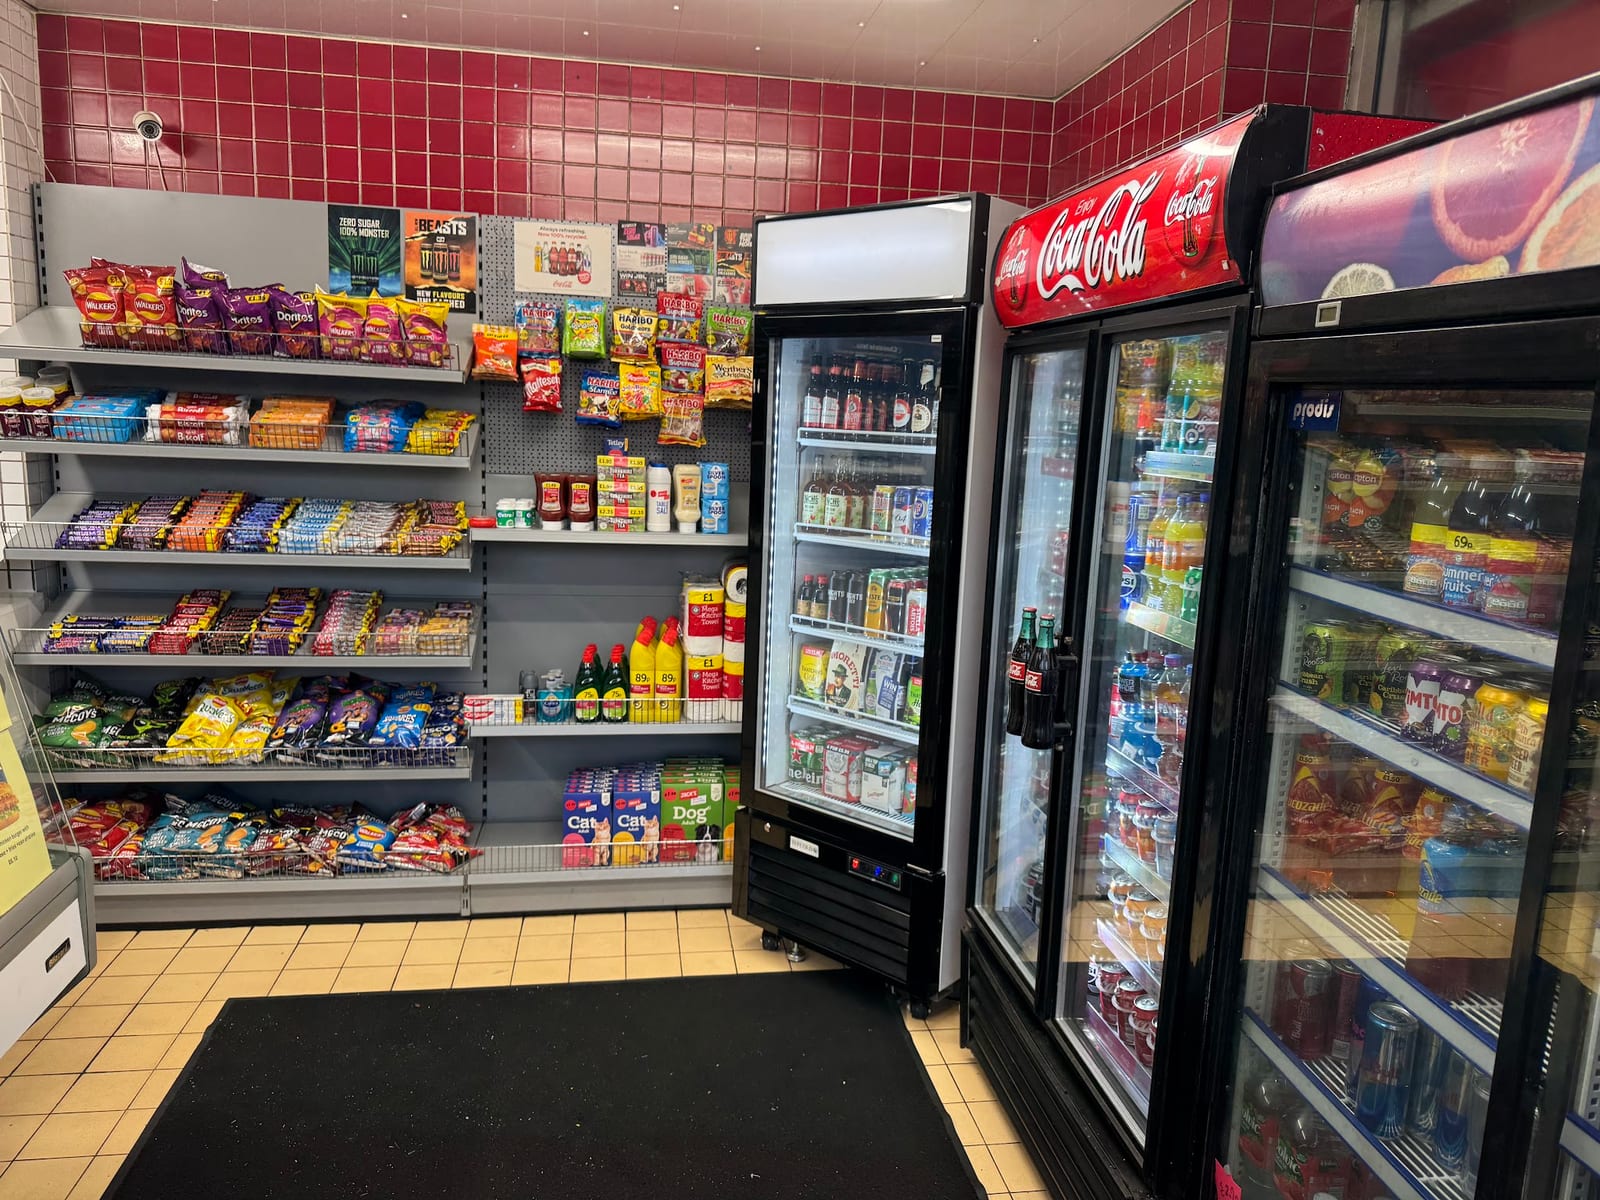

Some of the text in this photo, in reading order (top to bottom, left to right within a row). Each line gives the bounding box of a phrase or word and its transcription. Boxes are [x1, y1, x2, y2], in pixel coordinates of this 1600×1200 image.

[1074, 197, 1099, 216] Enjoy
[1164, 175, 1219, 226] Coca-Cola
[339, 217, 381, 229] ZERO SUGAR
[419, 218, 467, 236] BEASTS
[339, 227, 390, 239] 100% MONSTER
[1036, 167, 1166, 300] Coca-Cola
[416, 290, 465, 300] NEW FLAVOURS
[86, 301, 117, 311] WALKERS
[135, 301, 164, 312] WALKERS
[663, 296, 698, 310] HARIBO
[277, 310, 314, 322] Doritos
[522, 308, 556, 318] HARIBO
[619, 314, 653, 325] HARIBO
[713, 313, 746, 326] HARIBO
[666, 349, 701, 361] HARIBO
[712, 362, 752, 374] Werther's
[587, 376, 620, 389] HARIBO
[1292, 400, 1335, 427] prodis
[607, 439, 624, 449] Tetley
[1453, 535, 1473, 549] 69p
[1442, 567, 1482, 582] ummer
[1121, 576, 1135, 586] PSI
[1442, 578, 1472, 594] fruits
[703, 593, 714, 602] £1
[701, 605, 718, 613] Mega
[701, 618, 719, 626] Towel
[703, 659, 714, 667] £1
[1303, 656, 1328, 667] Roots
[701, 671, 718, 679] Mega
[831, 651, 860, 689] MORETTI
[635, 673, 650, 683] 89p
[661, 673, 676, 683] 89p
[1391, 671, 1407, 683] Roo
[701, 683, 719, 691] Towel
[883, 679, 897, 692] WIN
[199, 701, 236, 724] Quavers
[423, 726, 458, 734] ISCOS
[672, 805, 708, 824] Dog
[567, 815, 597, 830] Cat
[617, 814, 647, 828] Cat
